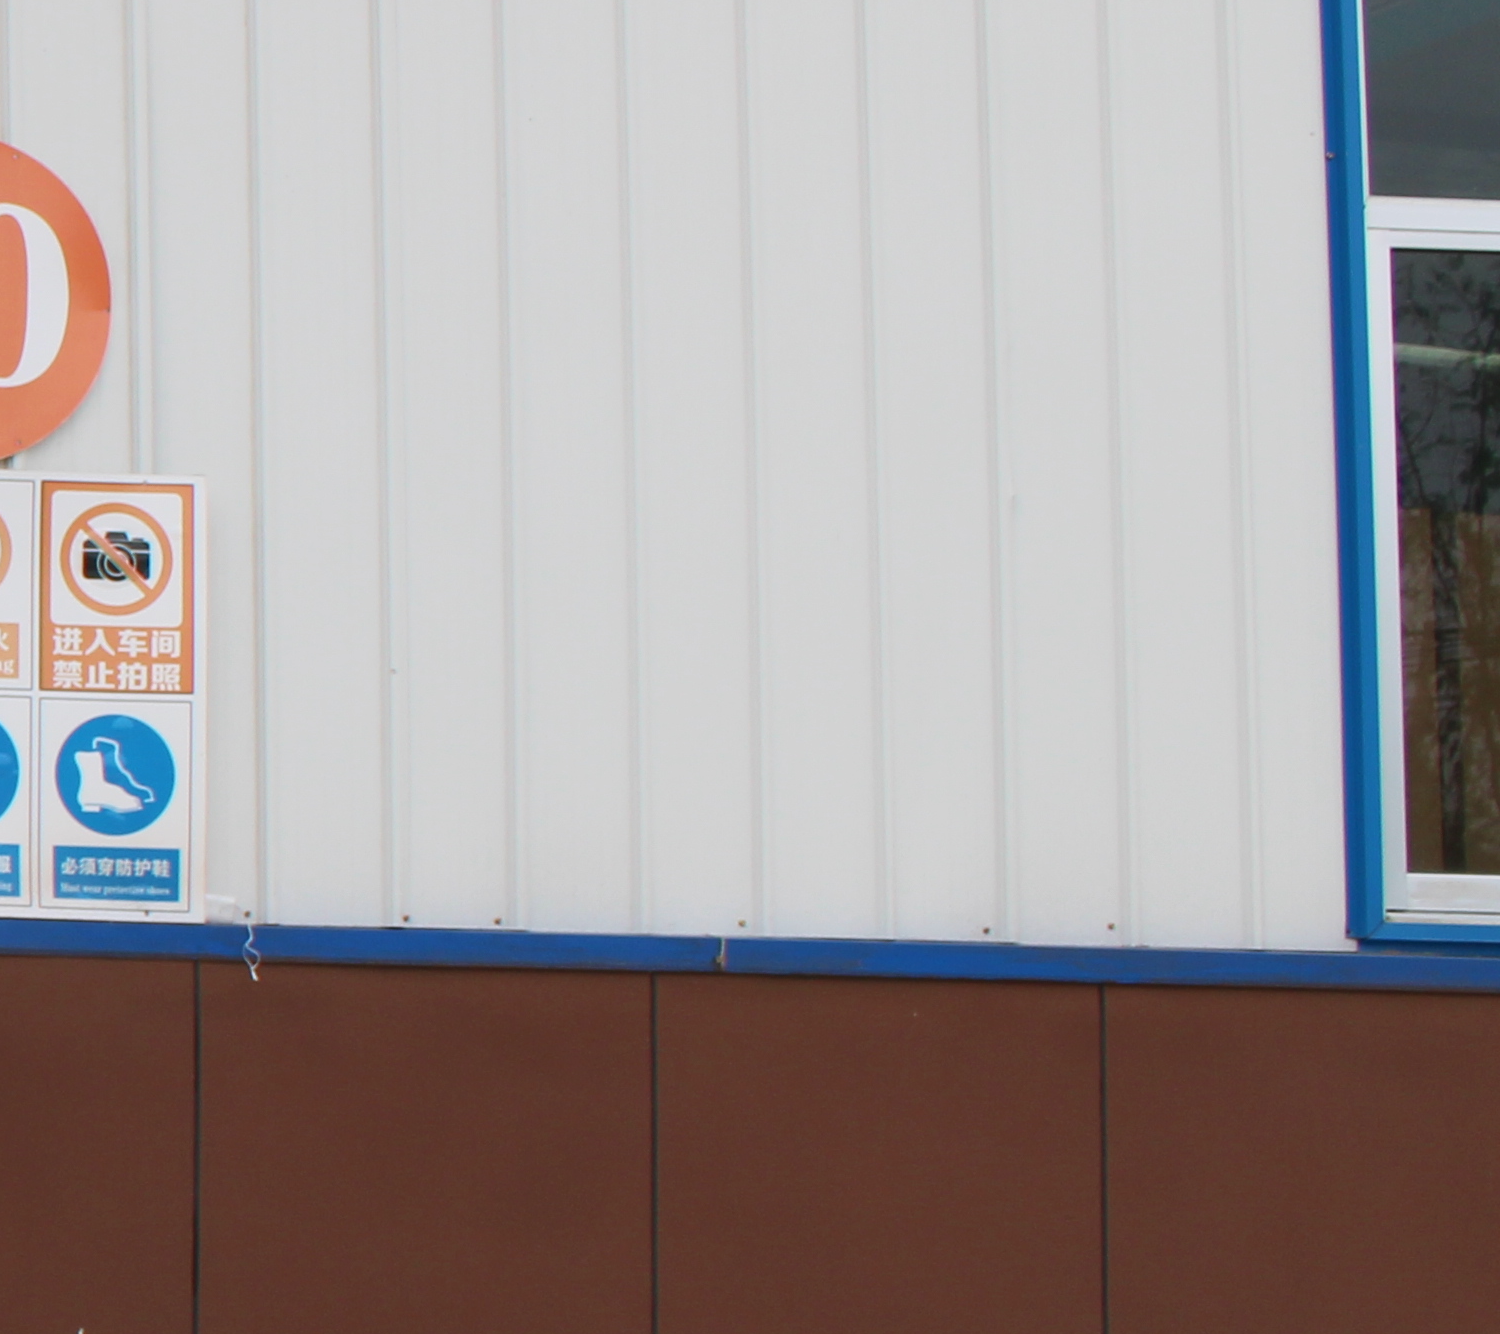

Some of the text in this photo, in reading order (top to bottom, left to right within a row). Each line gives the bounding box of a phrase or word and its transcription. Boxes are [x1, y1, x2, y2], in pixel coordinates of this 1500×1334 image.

[52, 627, 181, 658] 进入车间
[52, 660, 181, 691] 禁止拍照
[61, 857, 171, 877] 必须穿防护鞋
